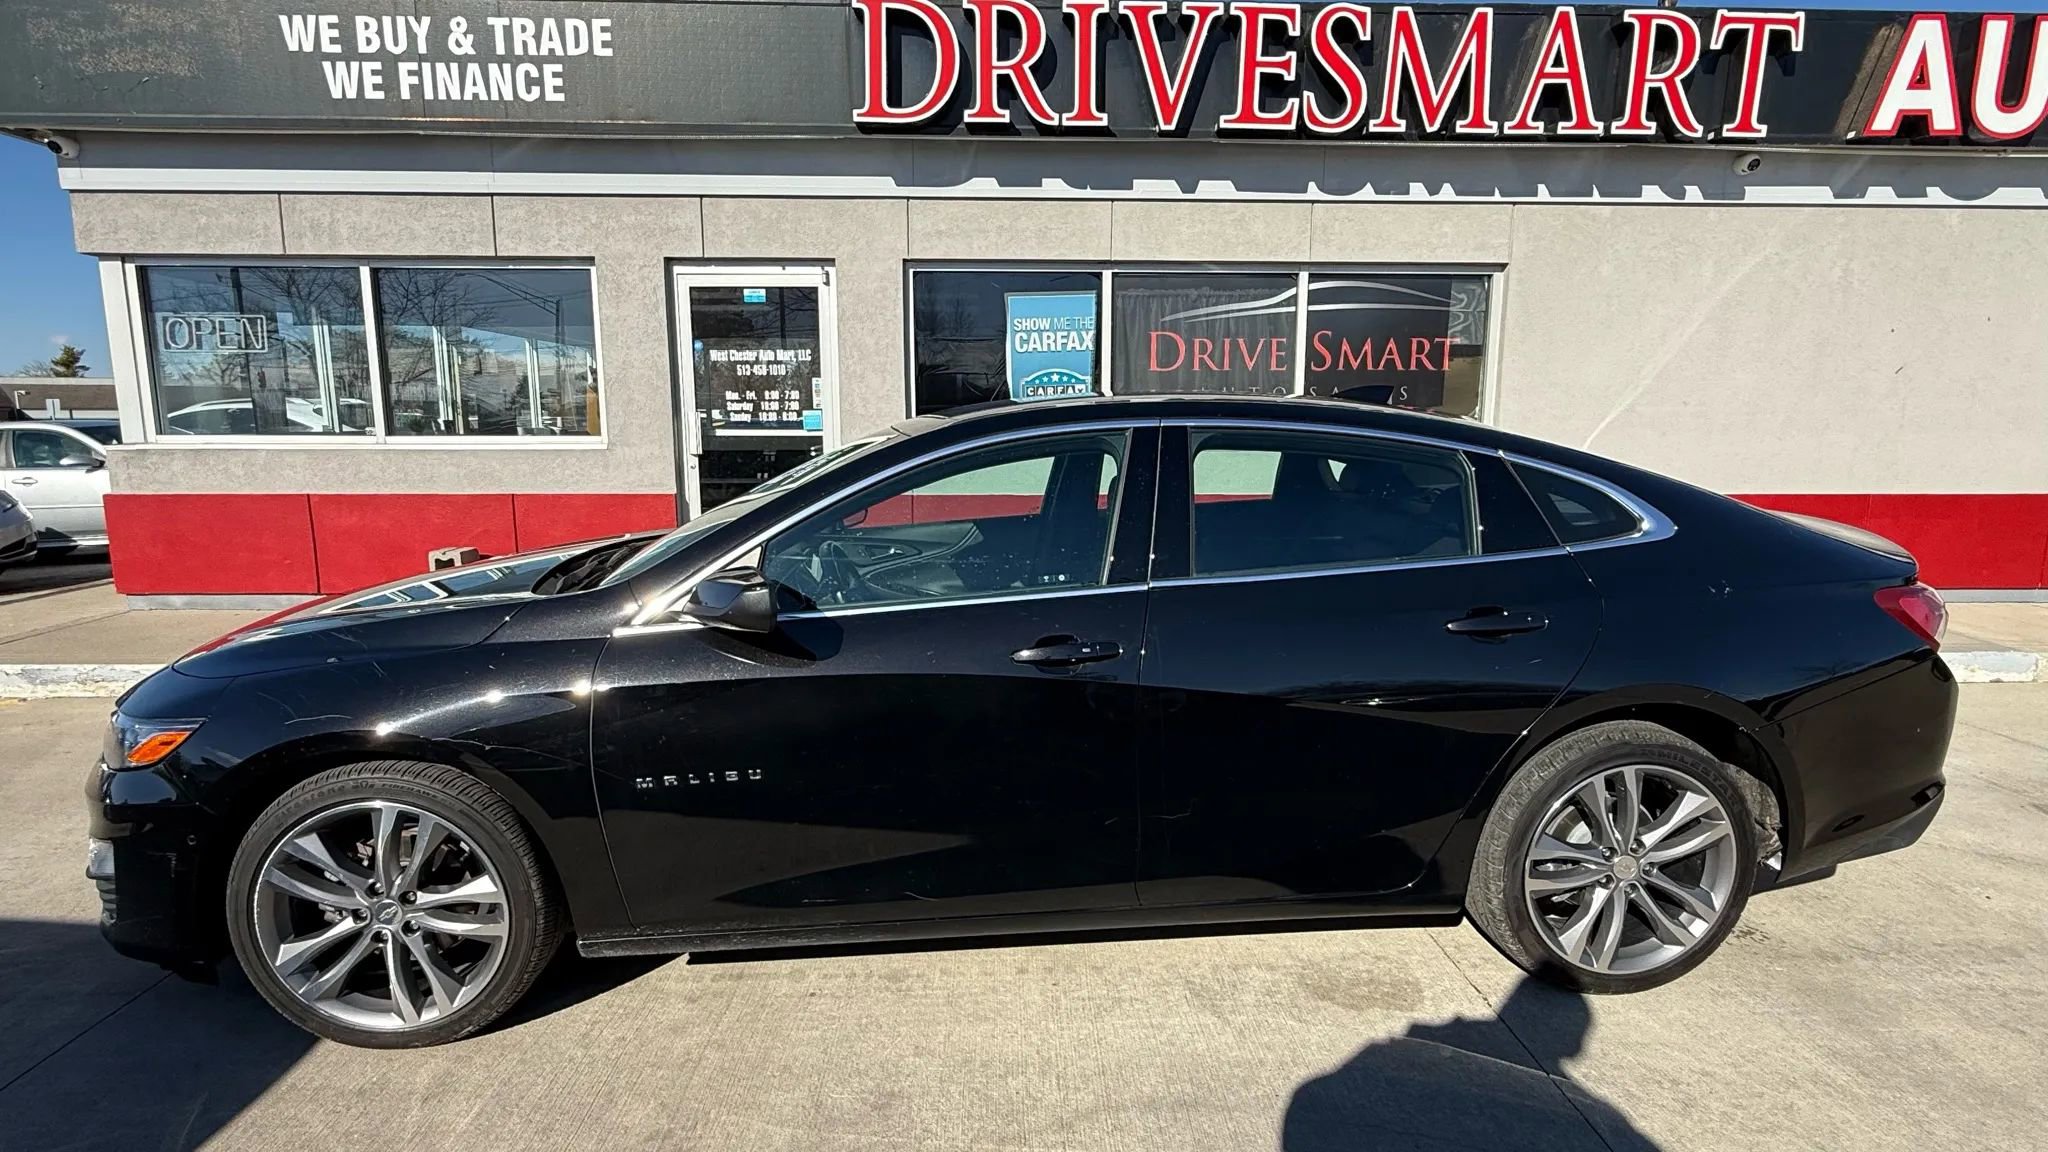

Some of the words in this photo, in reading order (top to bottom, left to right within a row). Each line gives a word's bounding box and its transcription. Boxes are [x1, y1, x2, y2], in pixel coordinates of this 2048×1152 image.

[279, 14, 341, 53] WE
[355, 15, 432, 55] BUY
[447, 15, 475, 56] &
[487, 16, 614, 57] TRADE
[322, 60, 385, 100] WE
[399, 61, 566, 102] FINANCE
[853, 0, 1806, 139] DRIVESMART
[164, 317, 264, 351] OPEN
[1013, 318, 1051, 332] SHOW
[1053, 317, 1072, 331] ME
[1075, 316, 1095, 330] THE
[709, 349, 729, 362] West
[729, 350, 758, 362] Chester
[759, 350, 775, 362] Auto
[797, 349, 812, 361] LLC
[1014, 331, 1095, 353] CARFAX
[635, 769, 762, 789] MALIBU
